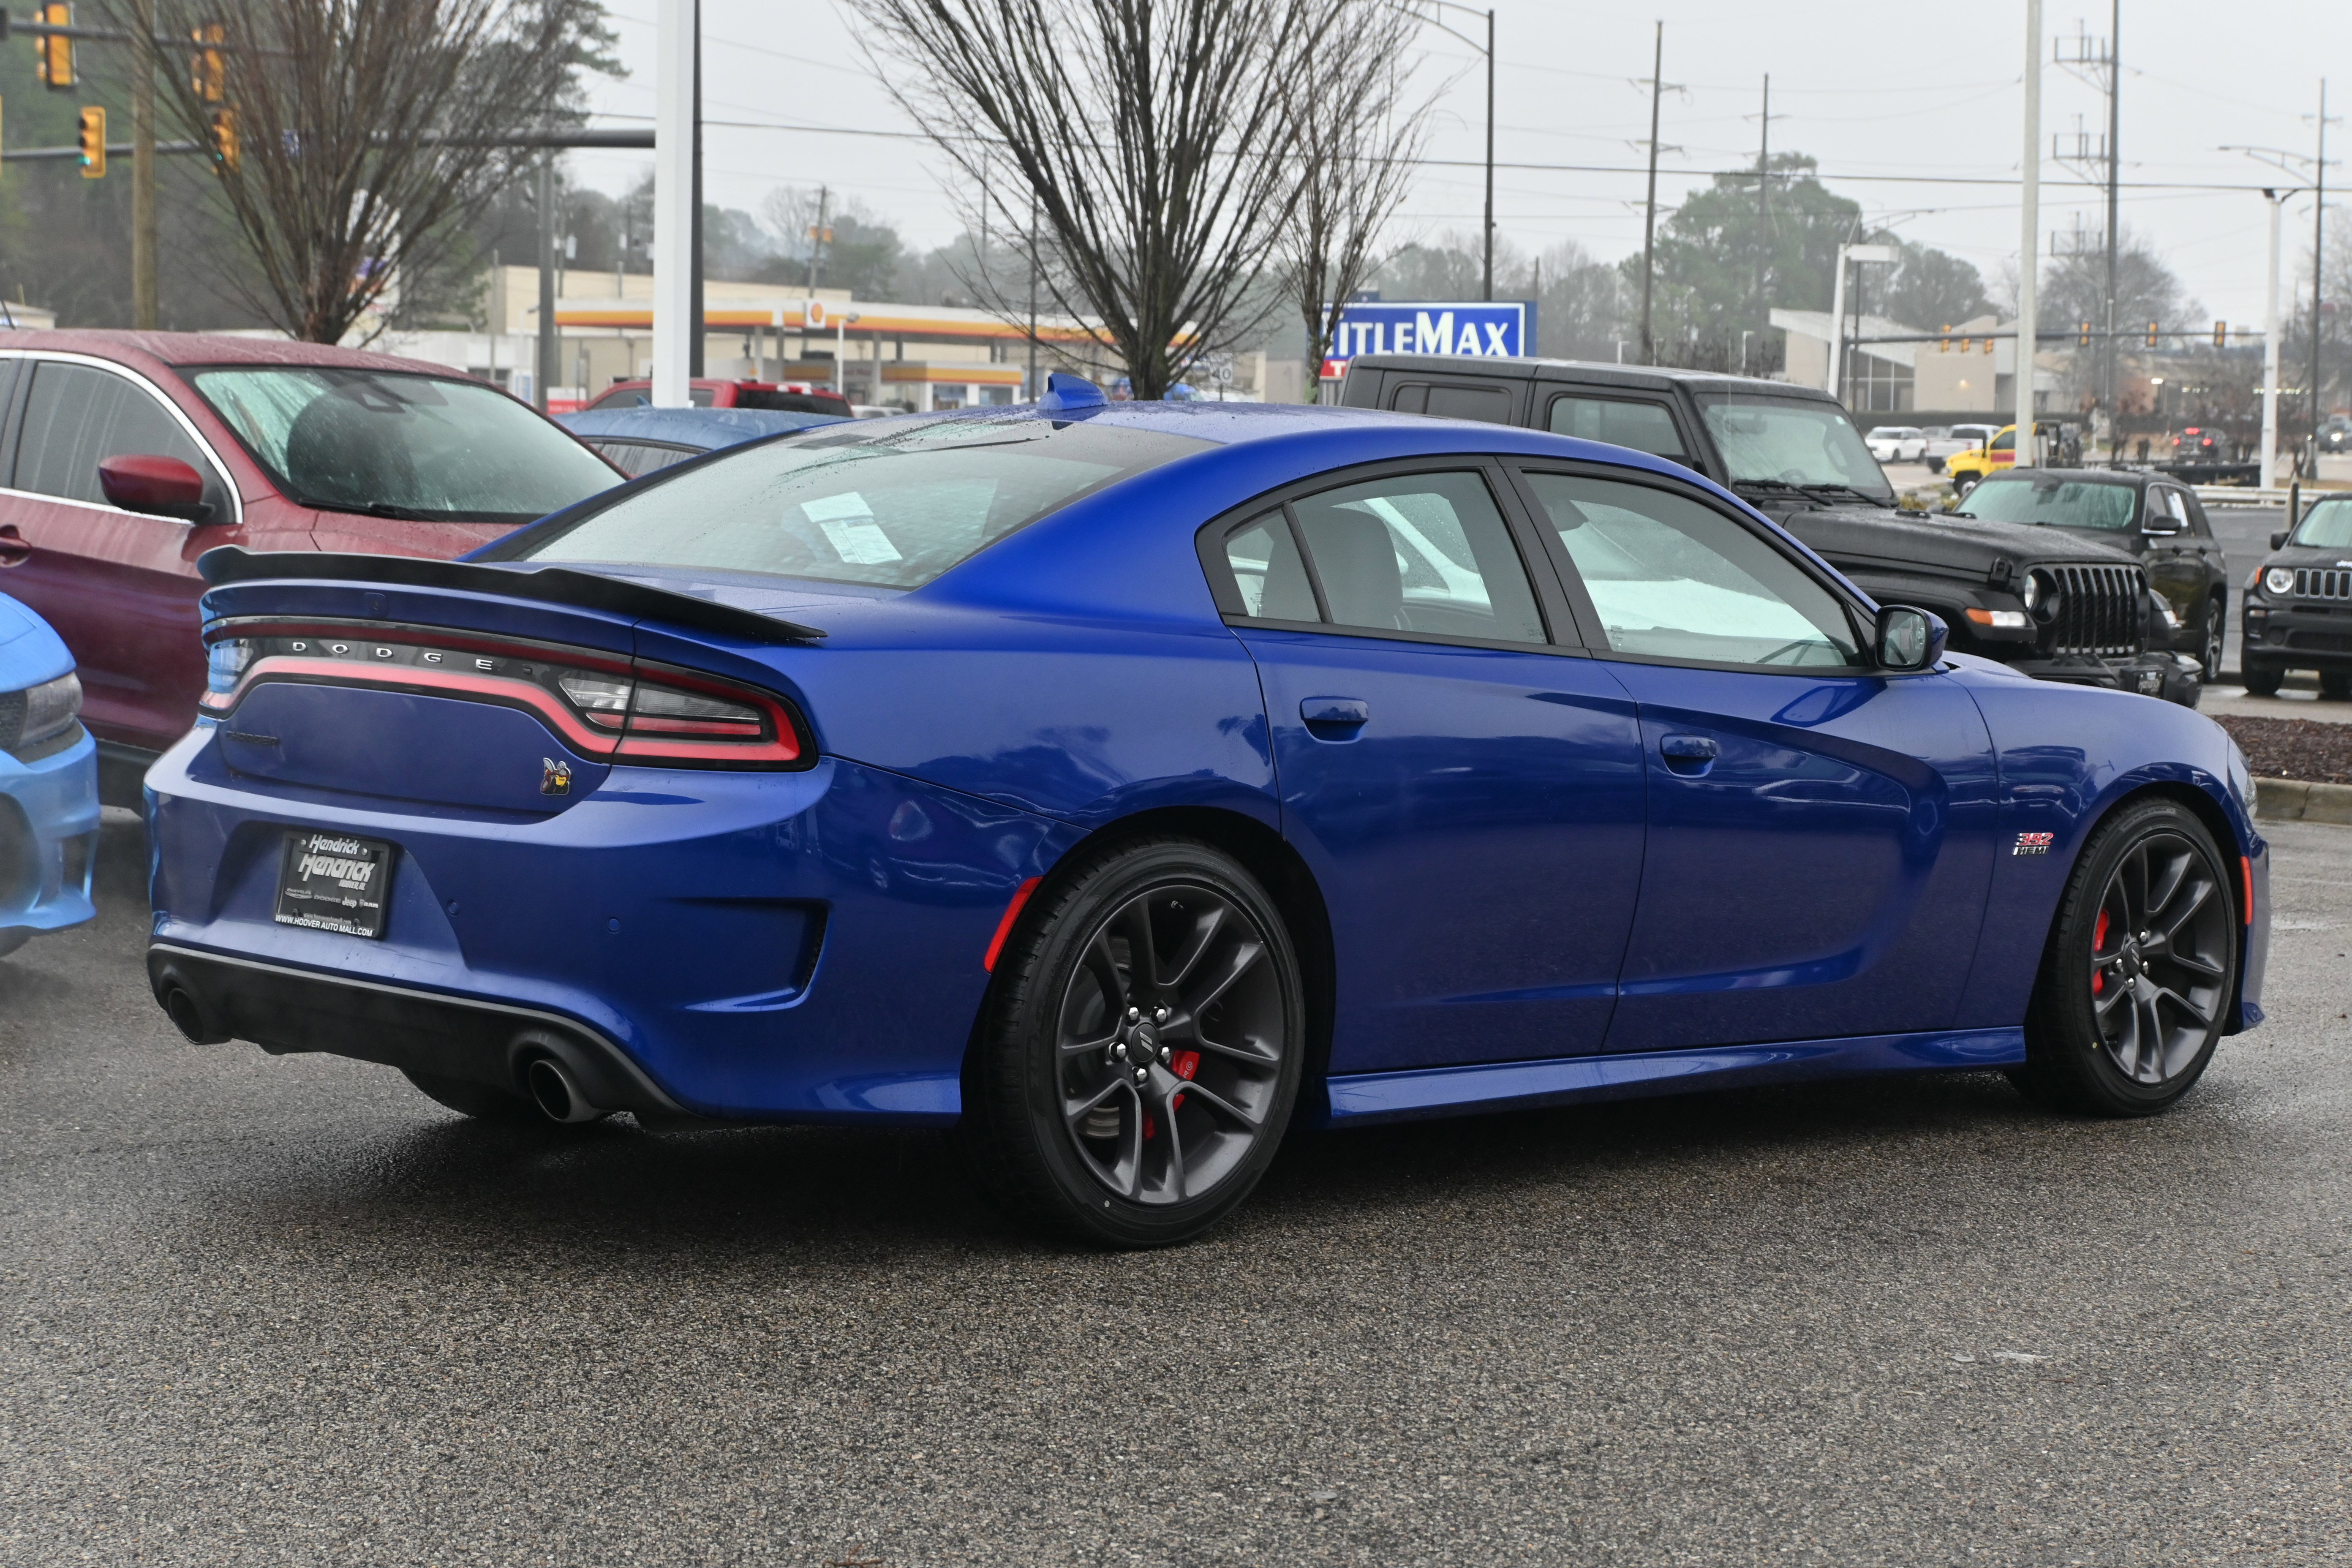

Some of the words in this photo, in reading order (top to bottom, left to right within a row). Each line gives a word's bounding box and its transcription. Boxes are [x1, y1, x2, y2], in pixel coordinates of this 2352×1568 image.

[293, 642, 493, 670] DODGE
[226, 730, 279, 746] CHARGER
[309, 834, 359, 855] Hendrick
[2014, 833, 2053, 846] 392
[2012, 846, 2049, 855] HEMI
[298, 854, 376, 882] Hendrick
[314, 895, 341, 904] DODGE
[342, 896, 357, 908] Jeep
[275, 914, 321, 928] WWW.HOOVER
[320, 922, 338, 931] AUTO
[339, 924, 373, 937] MALL.COM
